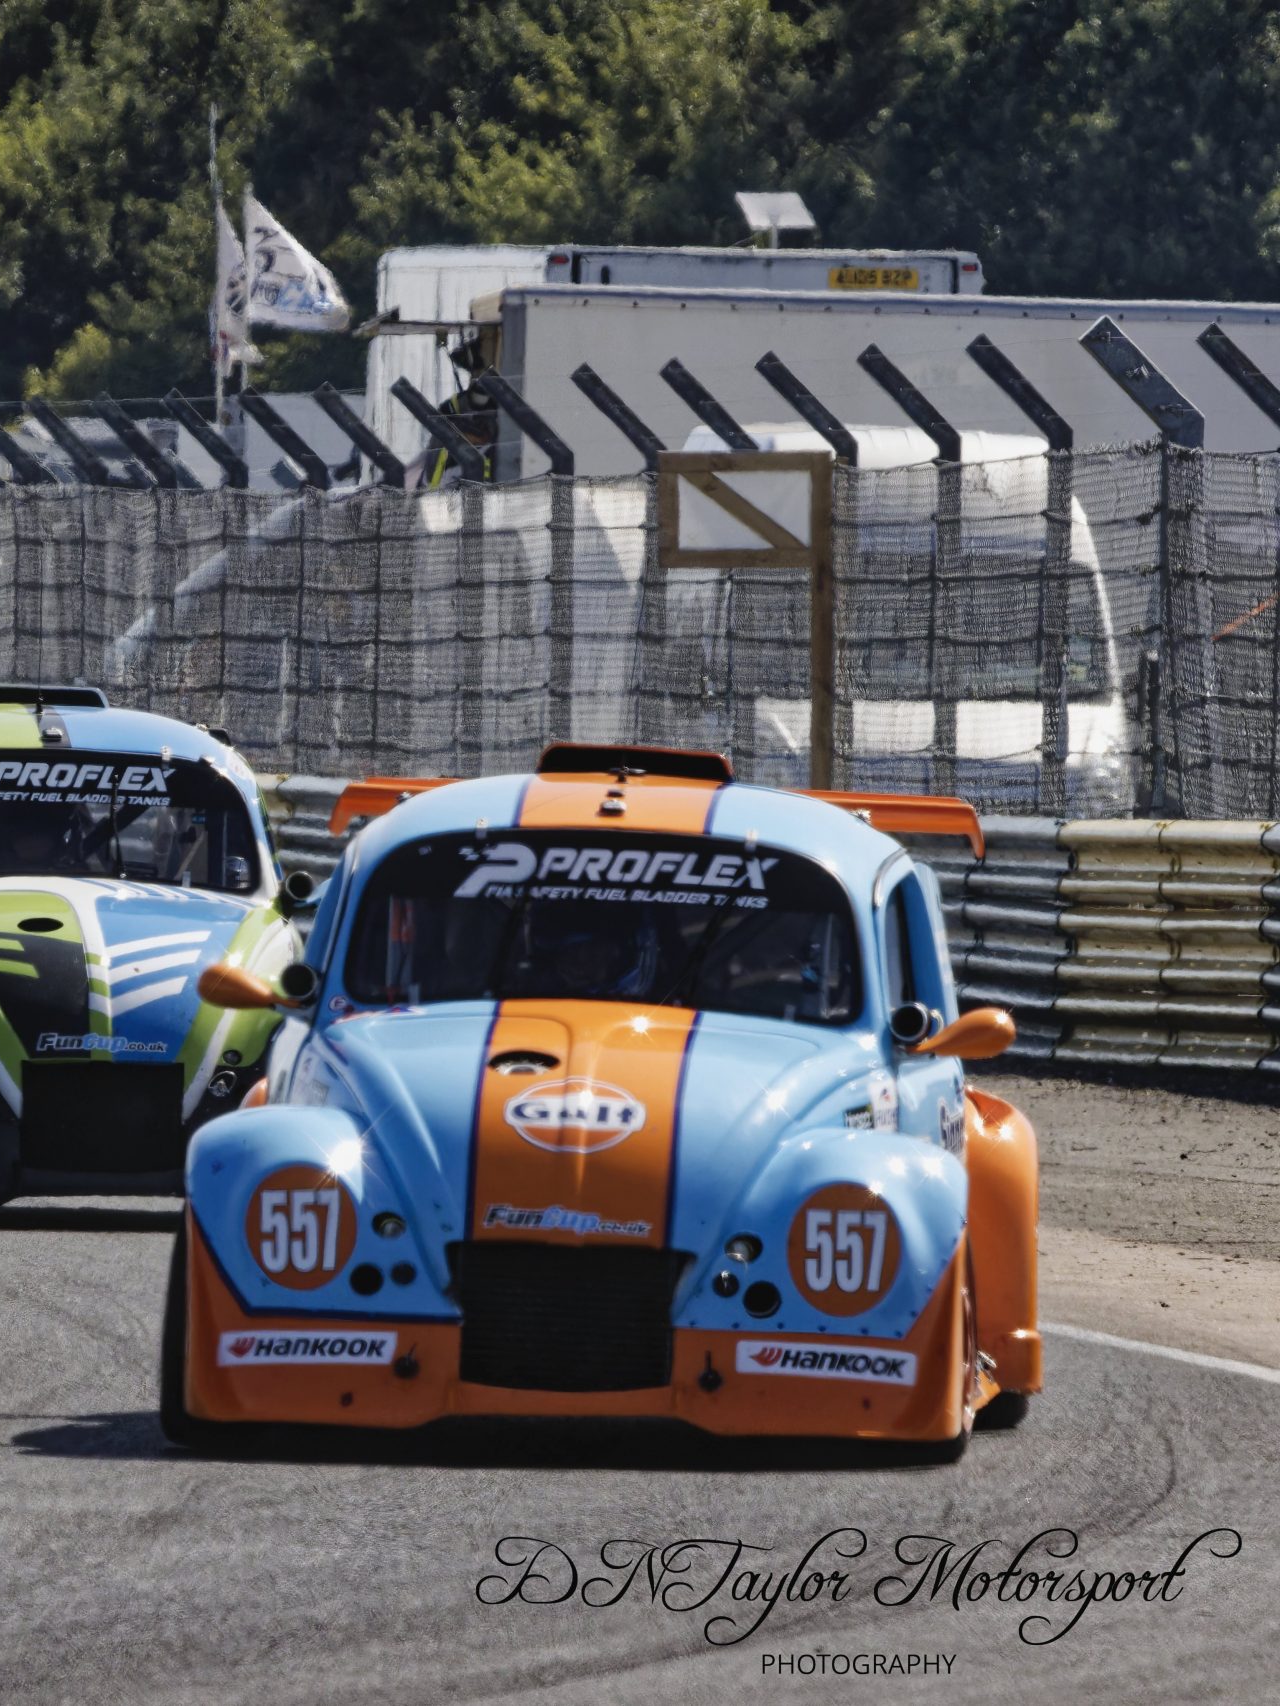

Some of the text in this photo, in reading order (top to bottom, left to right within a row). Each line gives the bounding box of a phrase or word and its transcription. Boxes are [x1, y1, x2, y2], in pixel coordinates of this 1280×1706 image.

[31, 792, 63, 802] FUEL
[64, 793, 126, 804] BLADDR
[128, 796, 170, 806] TANKS
[537, 847, 778, 890] PROFLEX
[485, 885, 513, 898] FIA
[586, 888, 626, 901] FUEL
[630, 890, 710, 905] BLADDER
[37, 1033, 168, 1053] FunCup.co.uk
[260, 1188, 340, 1273] 557
[804, 1208, 888, 1293] 557
